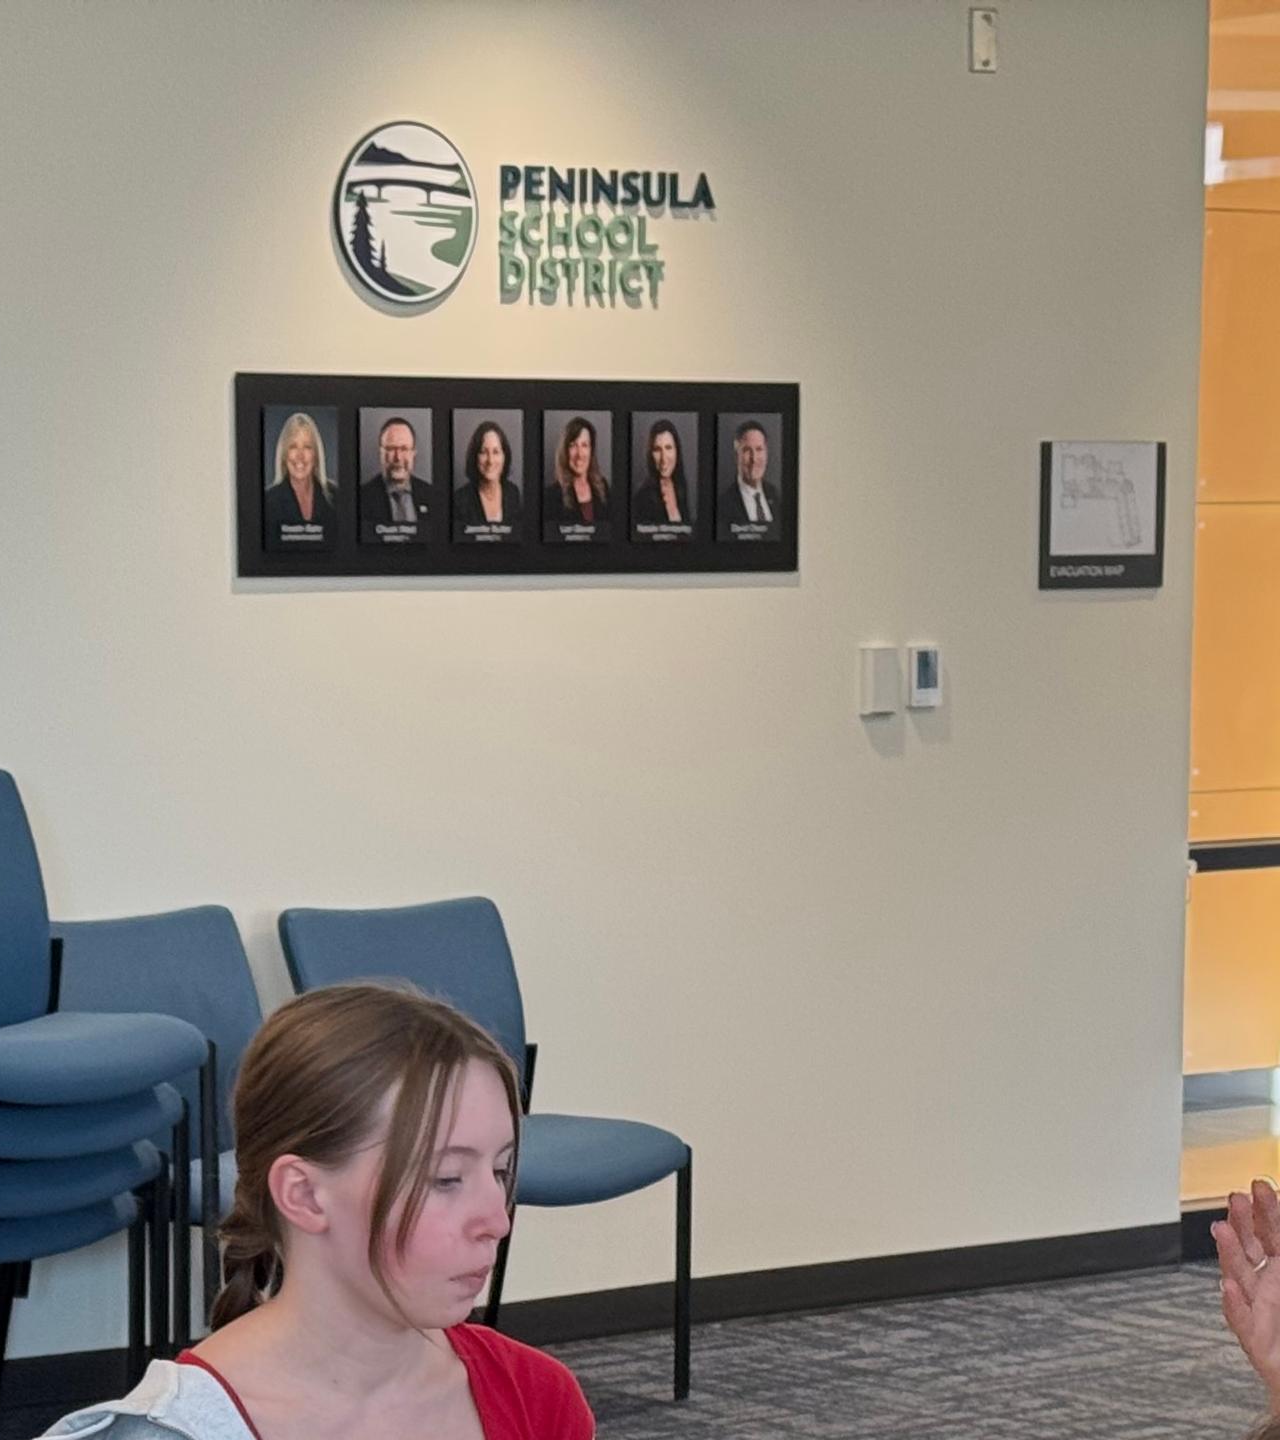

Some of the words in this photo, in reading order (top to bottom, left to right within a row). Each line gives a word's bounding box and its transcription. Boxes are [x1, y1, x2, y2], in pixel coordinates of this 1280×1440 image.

[499, 165, 716, 209] PENINSULA
[499, 211, 659, 256] SCHOOL
[499, 256, 665, 300] DISTRICT
